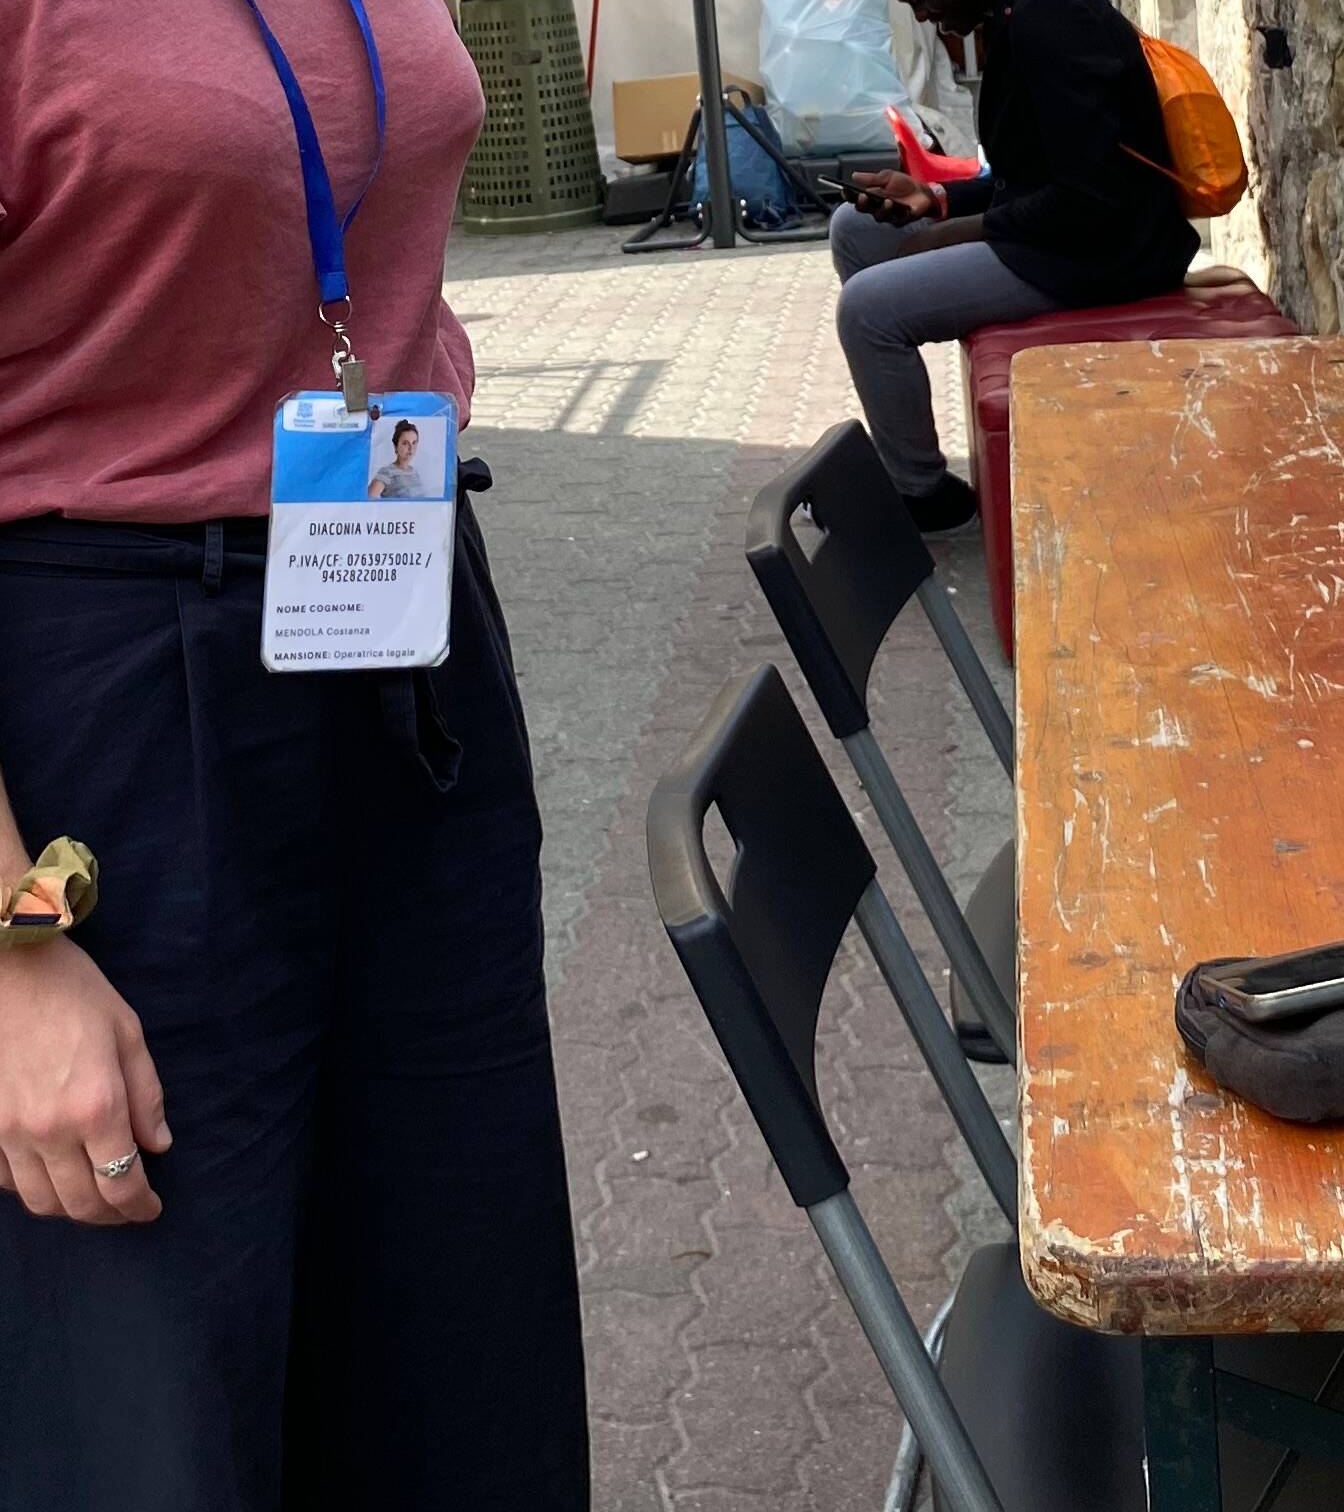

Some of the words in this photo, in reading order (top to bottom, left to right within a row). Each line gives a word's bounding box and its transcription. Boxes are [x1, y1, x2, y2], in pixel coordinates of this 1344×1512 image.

[309, 522, 362, 536] DIACONIA
[366, 521, 416, 535] VALDESE
[288, 554, 343, 570] P.IVA/CF:
[346, 553, 422, 567] 07639750012
[322, 569, 397, 582] 94528220018
[276, 605, 306, 614] NOME
[309, 603, 364, 613] COGNOME:
[275, 628, 323, 638] MENDOLA
[326, 627, 370, 636] Costanza
[274, 651, 331, 661] MANSIONE:
[333, 648, 384, 660] Operatrice
[386, 648, 416, 658] legale
